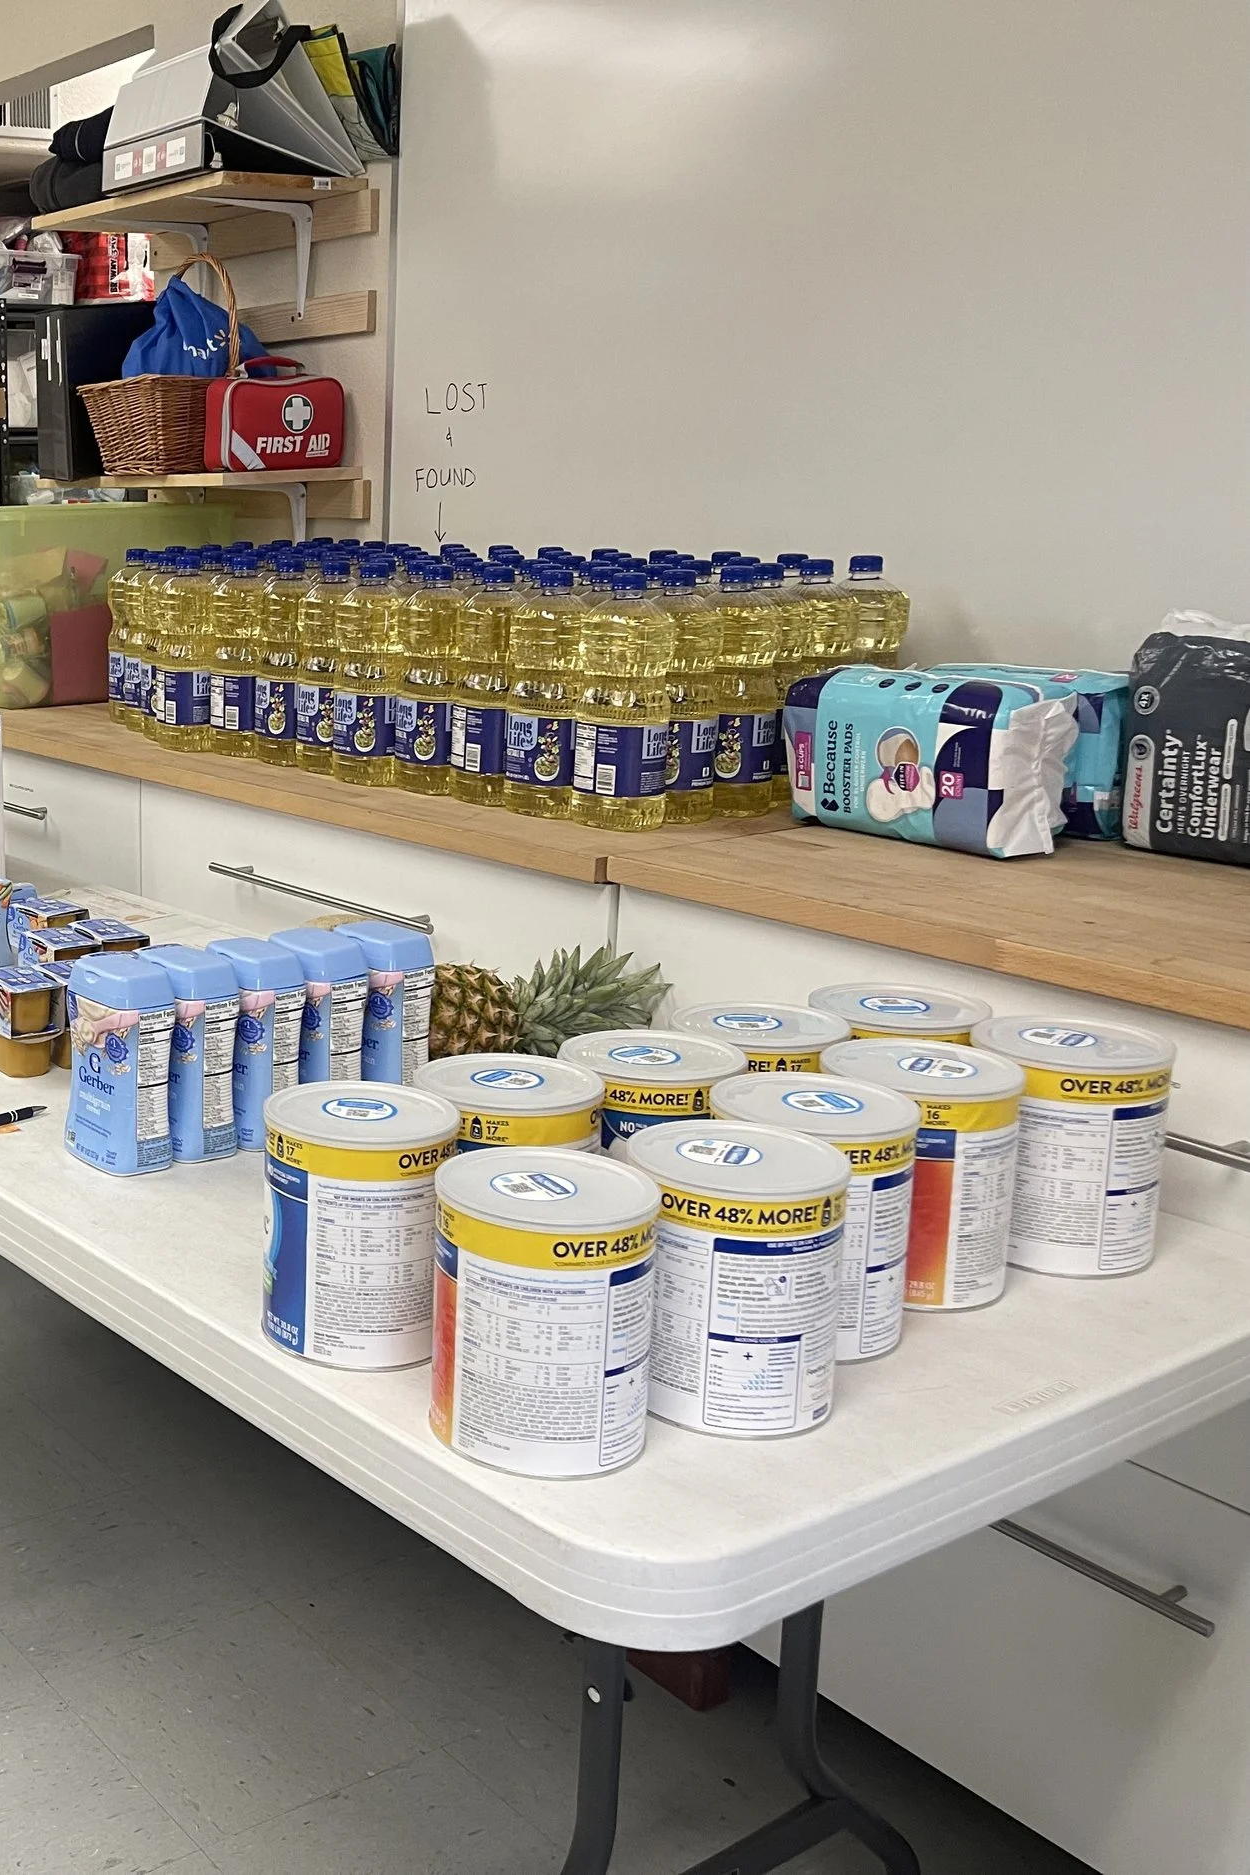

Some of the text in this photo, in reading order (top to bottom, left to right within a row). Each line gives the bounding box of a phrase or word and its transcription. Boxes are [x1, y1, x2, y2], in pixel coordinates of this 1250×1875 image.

[110, 259, 118, 293] BRWNY
[425, 382, 487, 414] LOST
[256, 433, 330, 454] FIRST AID
[415, 467, 476, 492] FOUND
[335, 694, 353, 713] Long
[1138, 691, 1149, 708] 4X
[510, 716, 533, 737] Long
[509, 732, 526, 749] Life
[822, 720, 839, 796] Because
[843, 723, 854, 814] BOOSTER PADS
[942, 773, 954, 796] 20
[1156, 731, 1183, 833] Certainty
[1187, 740, 1208, 837] ComfortLux
[1129, 765, 1143, 831] Walgreens
[1177, 751, 1191, 835] MEN'S OVERNIGHT
[1200, 748, 1222, 839] Underwear
[404, 971, 424, 979] Nutrition
[275, 992, 295, 1001] Nutrition
[332, 983, 354, 991] Nutrition
[139, 1012, 162, 1022] Nutrition
[748, 1061, 770, 1073] RE!
[79, 1066, 115, 1096] Gerber
[1060, 1079, 1112, 1094] OVER
[1115, 1079, 1144, 1093] 48%
[79, 1090, 111, 1112] multigrain
[609, 1090, 689, 1106] 48% MORE!
[86, 1105, 101, 1116] cereal
[927, 1111, 939, 1120] 16
[487, 1126, 497, 1135] 17
[619, 1120, 635, 1133] NO
[286, 1140, 303, 1149] MAKES
[286, 1147, 295, 1156] 17
[399, 1149, 439, 1169] OVER
[846, 1150, 870, 1164] ER
[661, 1193, 817, 1225] OVER 48% MORE!
[553, 1235, 639, 1258] OVER 48%
